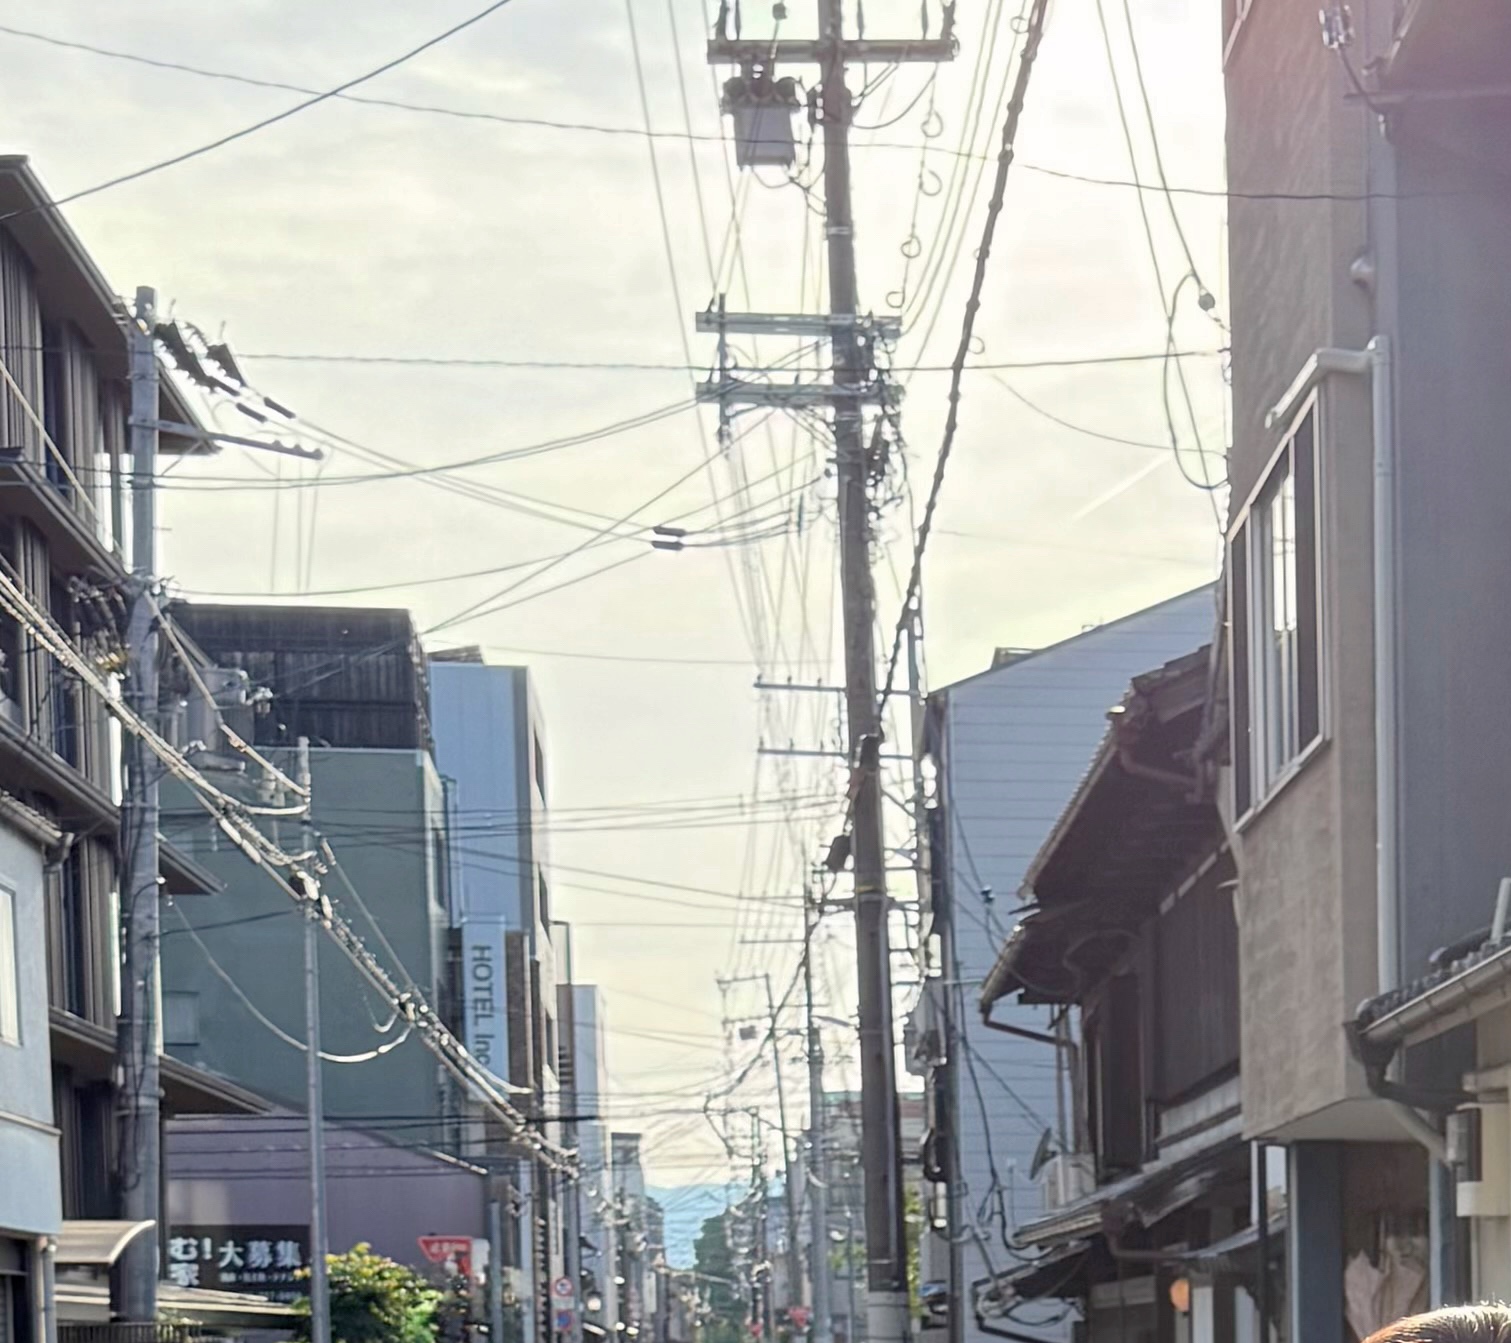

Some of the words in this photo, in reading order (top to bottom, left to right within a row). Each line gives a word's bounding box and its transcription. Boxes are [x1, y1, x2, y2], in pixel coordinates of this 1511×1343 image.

[471, 944, 495, 1027] HOTEL
[218, 1239, 302, 1269] 大募集
